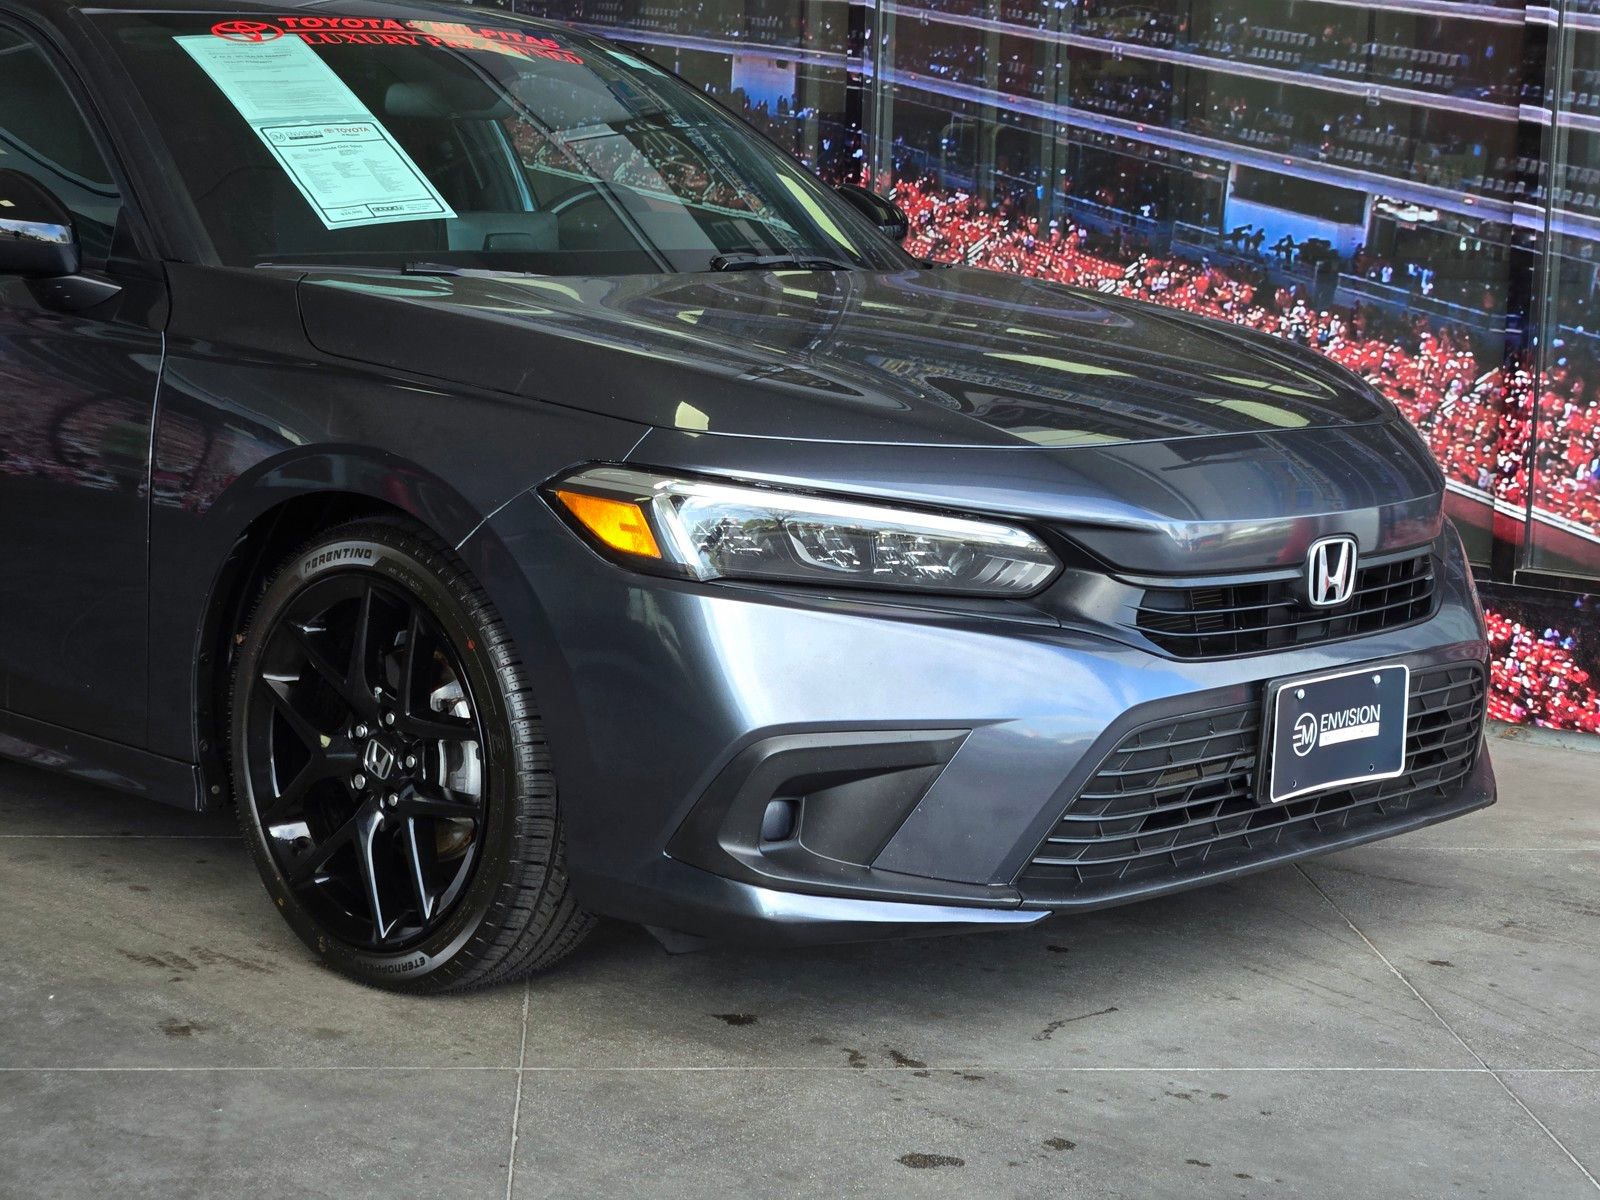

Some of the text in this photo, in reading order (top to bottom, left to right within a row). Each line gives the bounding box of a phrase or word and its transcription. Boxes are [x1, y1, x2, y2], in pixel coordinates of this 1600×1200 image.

[278, 17, 405, 31] TOYOTA
[429, 22, 560, 49] MILPITAS
[300, 33, 421, 46] LUXURY
[1320, 703, 1381, 732] ENVISION
